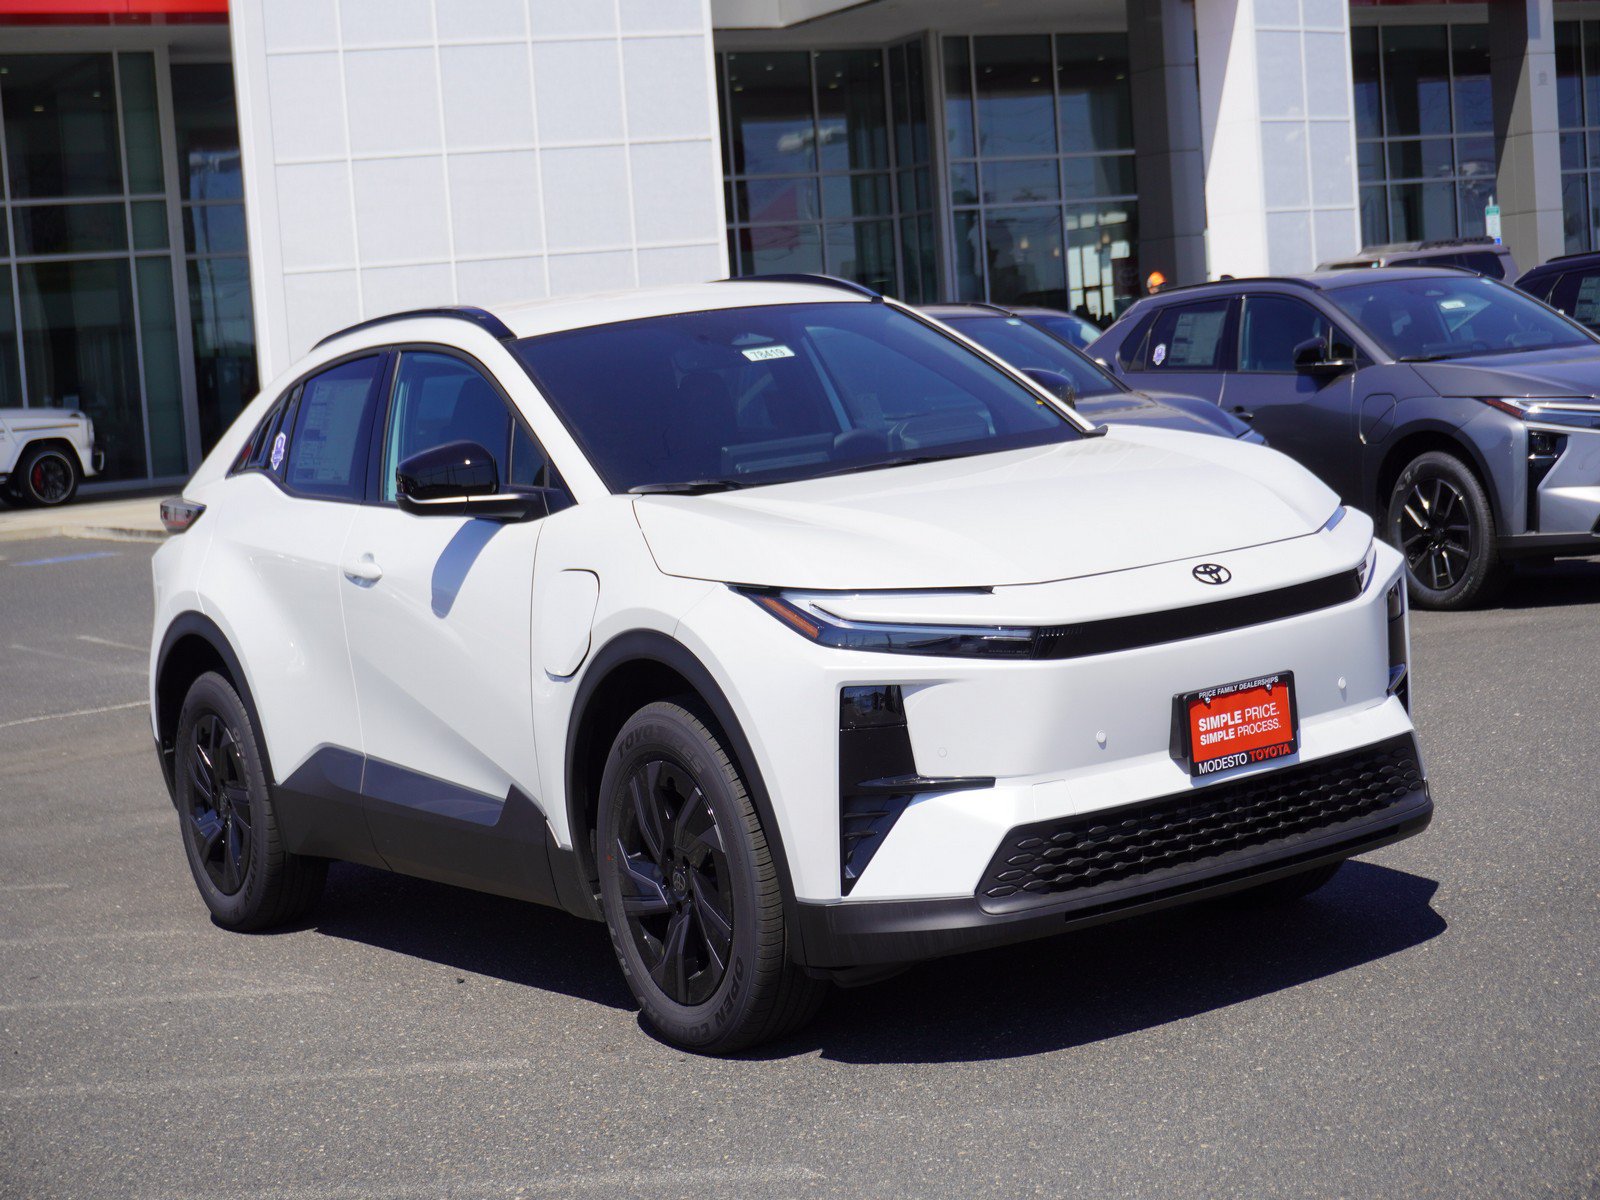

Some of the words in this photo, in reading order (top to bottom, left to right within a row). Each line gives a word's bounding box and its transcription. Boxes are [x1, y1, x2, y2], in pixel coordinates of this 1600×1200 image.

[1198, 688, 1216, 699] PRICE
[1217, 685, 1238, 696] FAMILY
[1238, 676, 1279, 690] DEALERSHIPS
[1198, 710, 1242, 732] SIMPLE
[1244, 702, 1280, 720] PRICE.
[1200, 728, 1235, 746] SIMPLE
[1237, 718, 1281, 738] PROCESS.
[1198, 753, 1248, 775] MODESTO
[1249, 743, 1291, 762] TOYOTA
